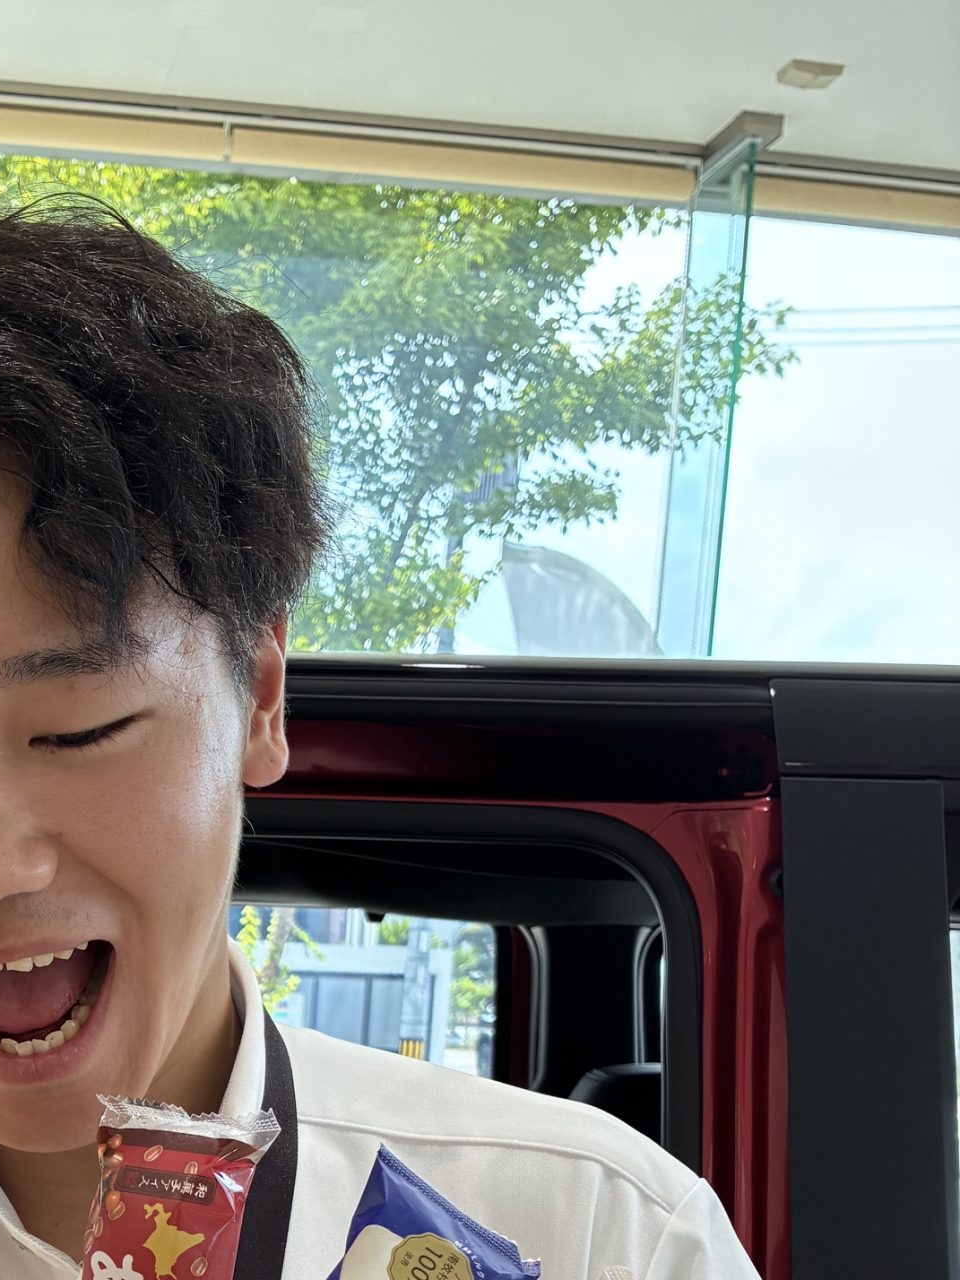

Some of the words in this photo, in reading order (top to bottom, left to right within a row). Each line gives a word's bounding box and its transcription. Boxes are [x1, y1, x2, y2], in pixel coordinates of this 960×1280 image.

[138, 1174, 207, 1198] 和菓子アイス
